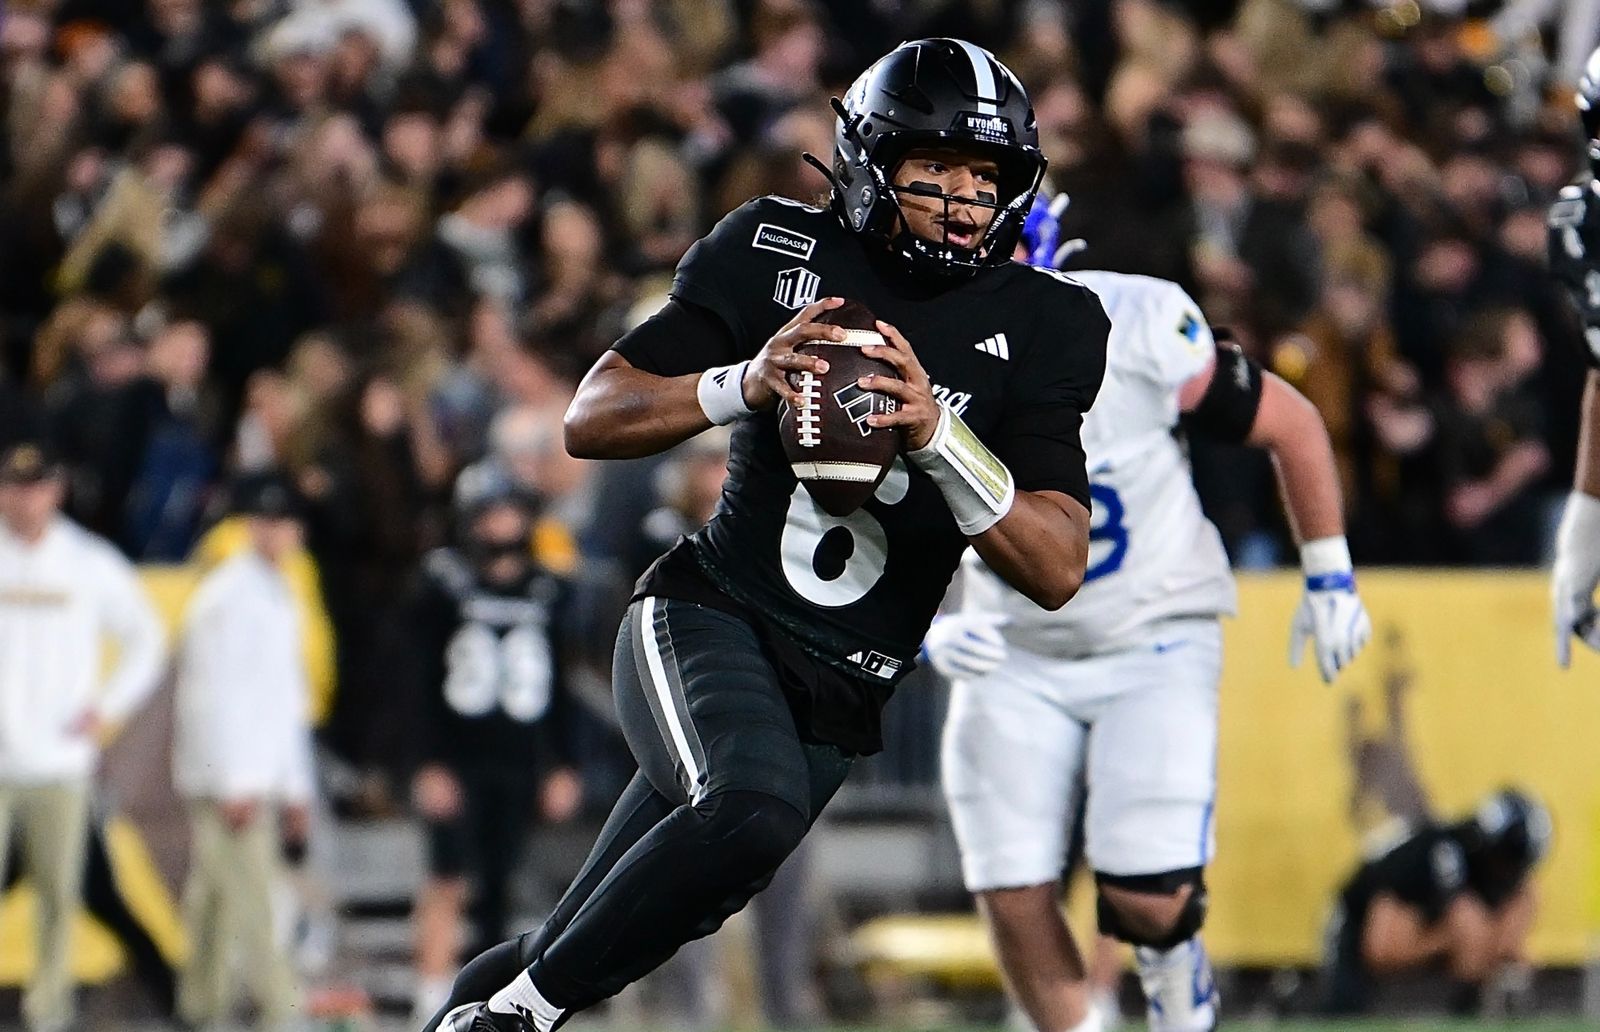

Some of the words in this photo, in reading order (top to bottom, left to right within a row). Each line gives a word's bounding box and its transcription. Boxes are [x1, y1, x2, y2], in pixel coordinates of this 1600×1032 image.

[967, 117, 1008, 133] WYOMING
[760, 231, 802, 249] TALLGRASS
[780, 453, 910, 607] 6
